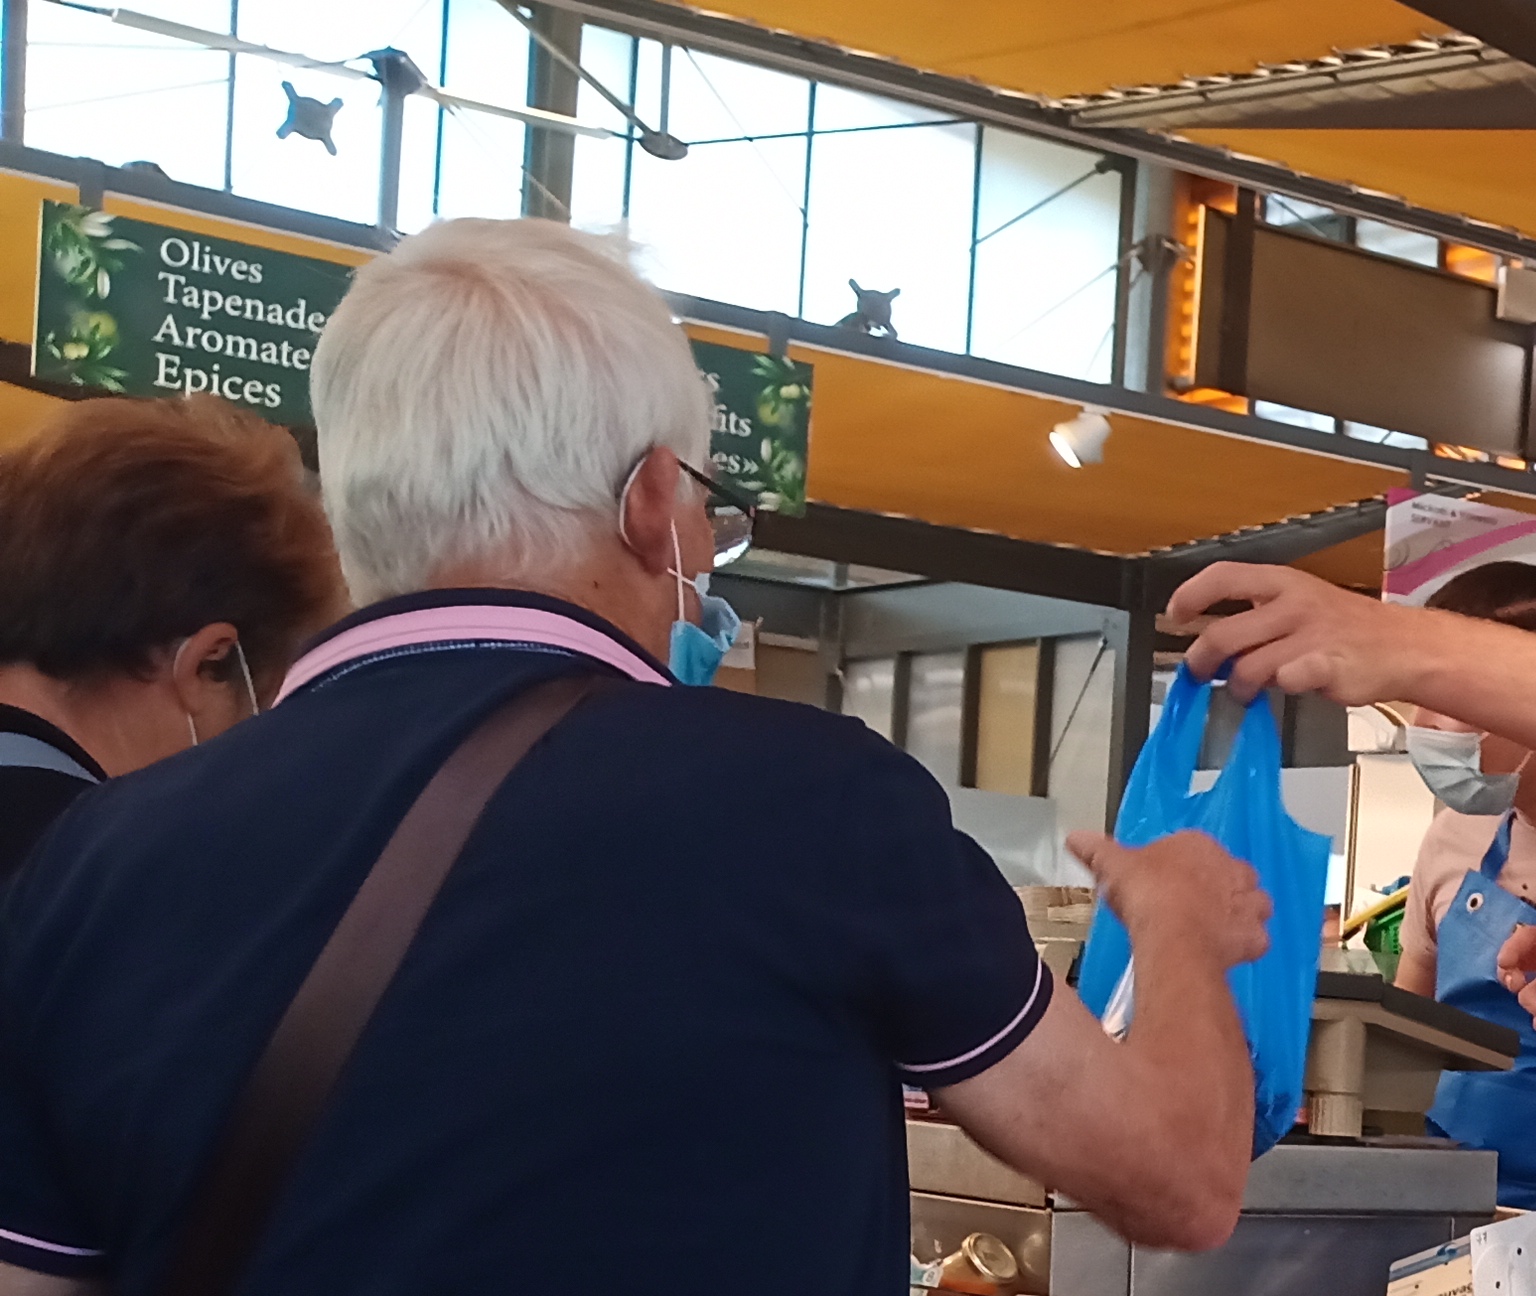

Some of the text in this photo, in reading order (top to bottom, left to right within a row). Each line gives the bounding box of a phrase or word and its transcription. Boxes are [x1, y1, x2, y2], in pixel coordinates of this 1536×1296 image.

[160, 237, 263, 284] Olives
[157, 271, 327, 334] Tapenade
[151, 313, 312, 370] Aromate
[153, 352, 282, 408] Epices
